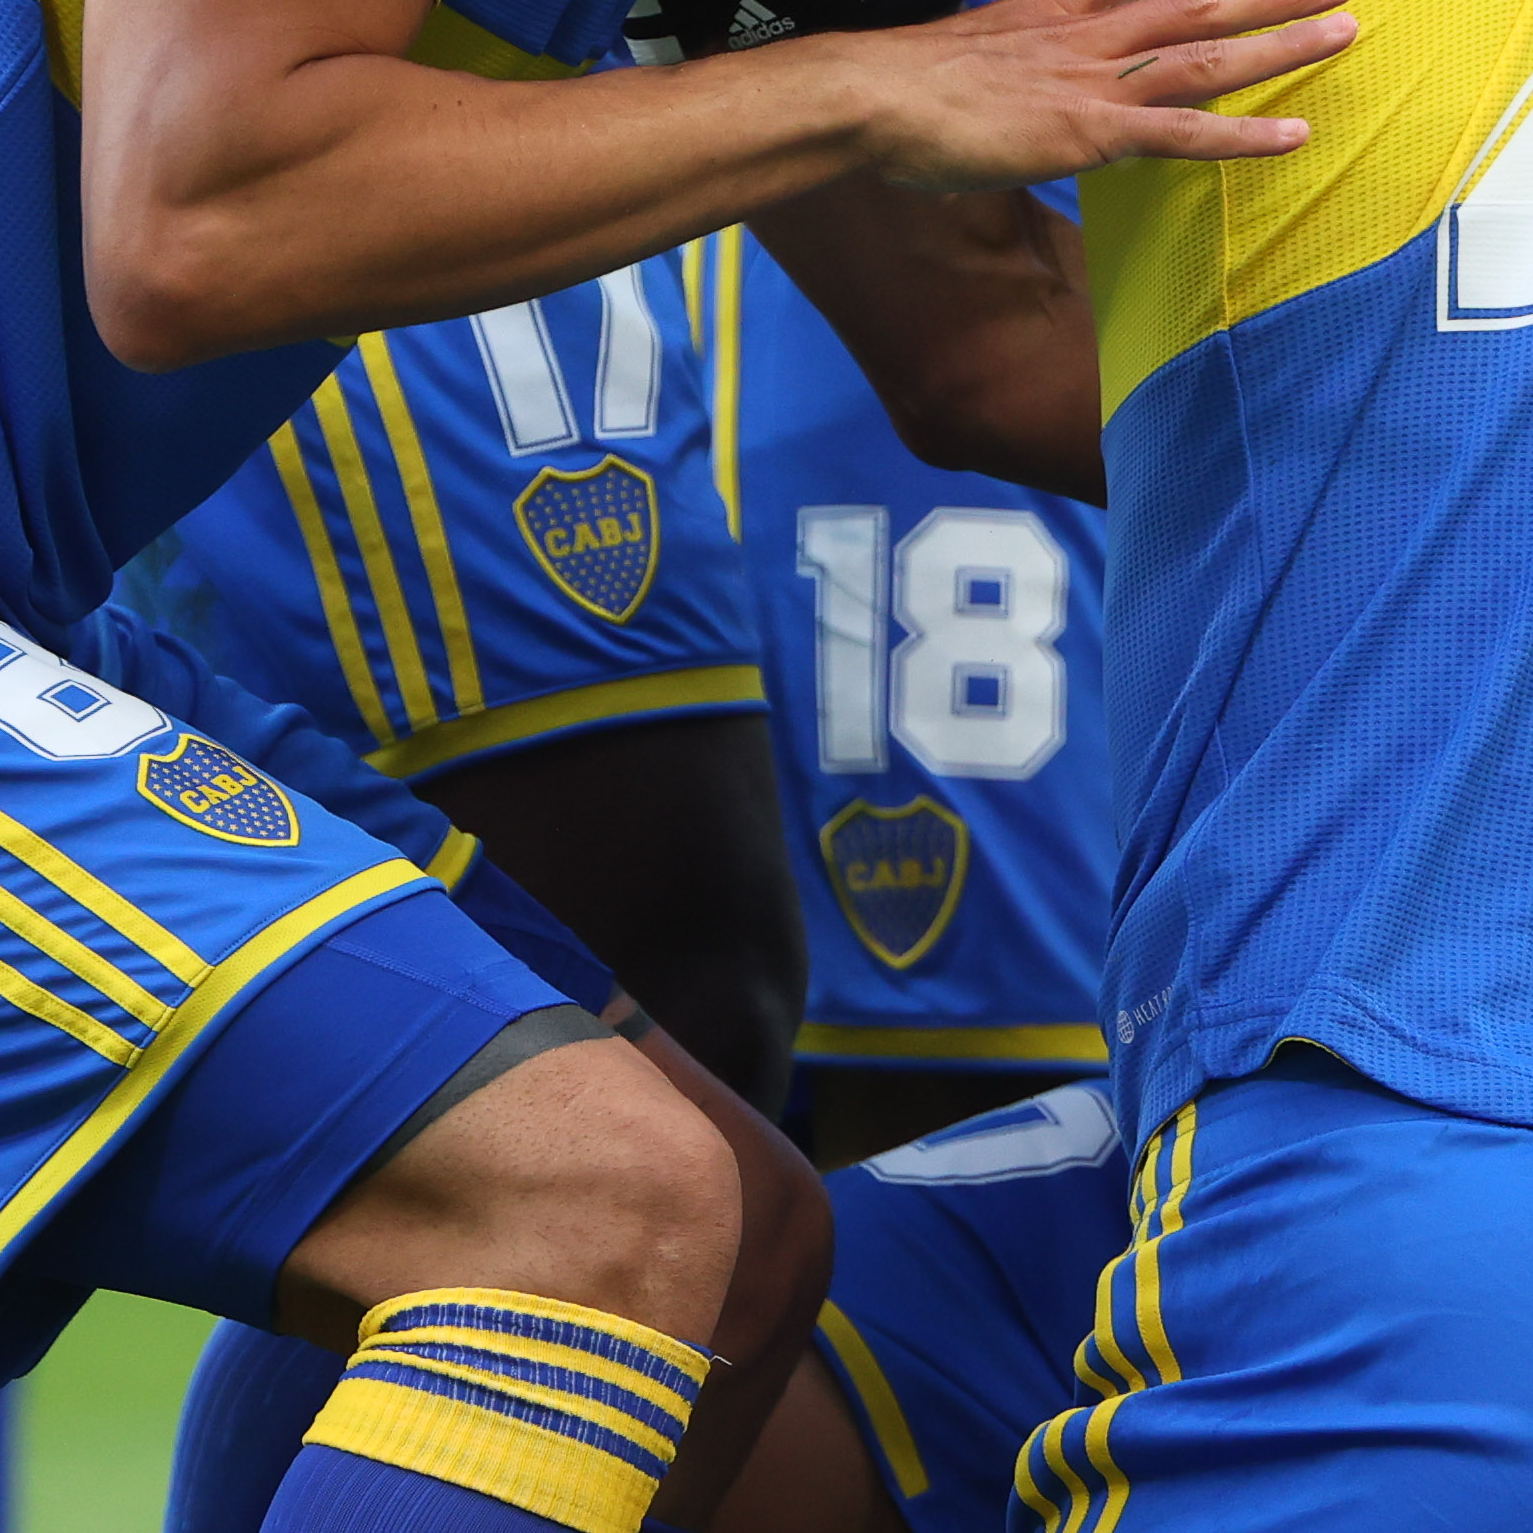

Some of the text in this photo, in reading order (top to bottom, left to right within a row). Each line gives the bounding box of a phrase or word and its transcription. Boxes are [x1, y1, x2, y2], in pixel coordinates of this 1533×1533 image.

[728, 16, 796, 50] adidas
[544, 511, 643, 558] CABJ
[795, 503, 1068, 780] 18
[178, 766, 259, 815] CABJ
[845, 856, 947, 893] CABJ
